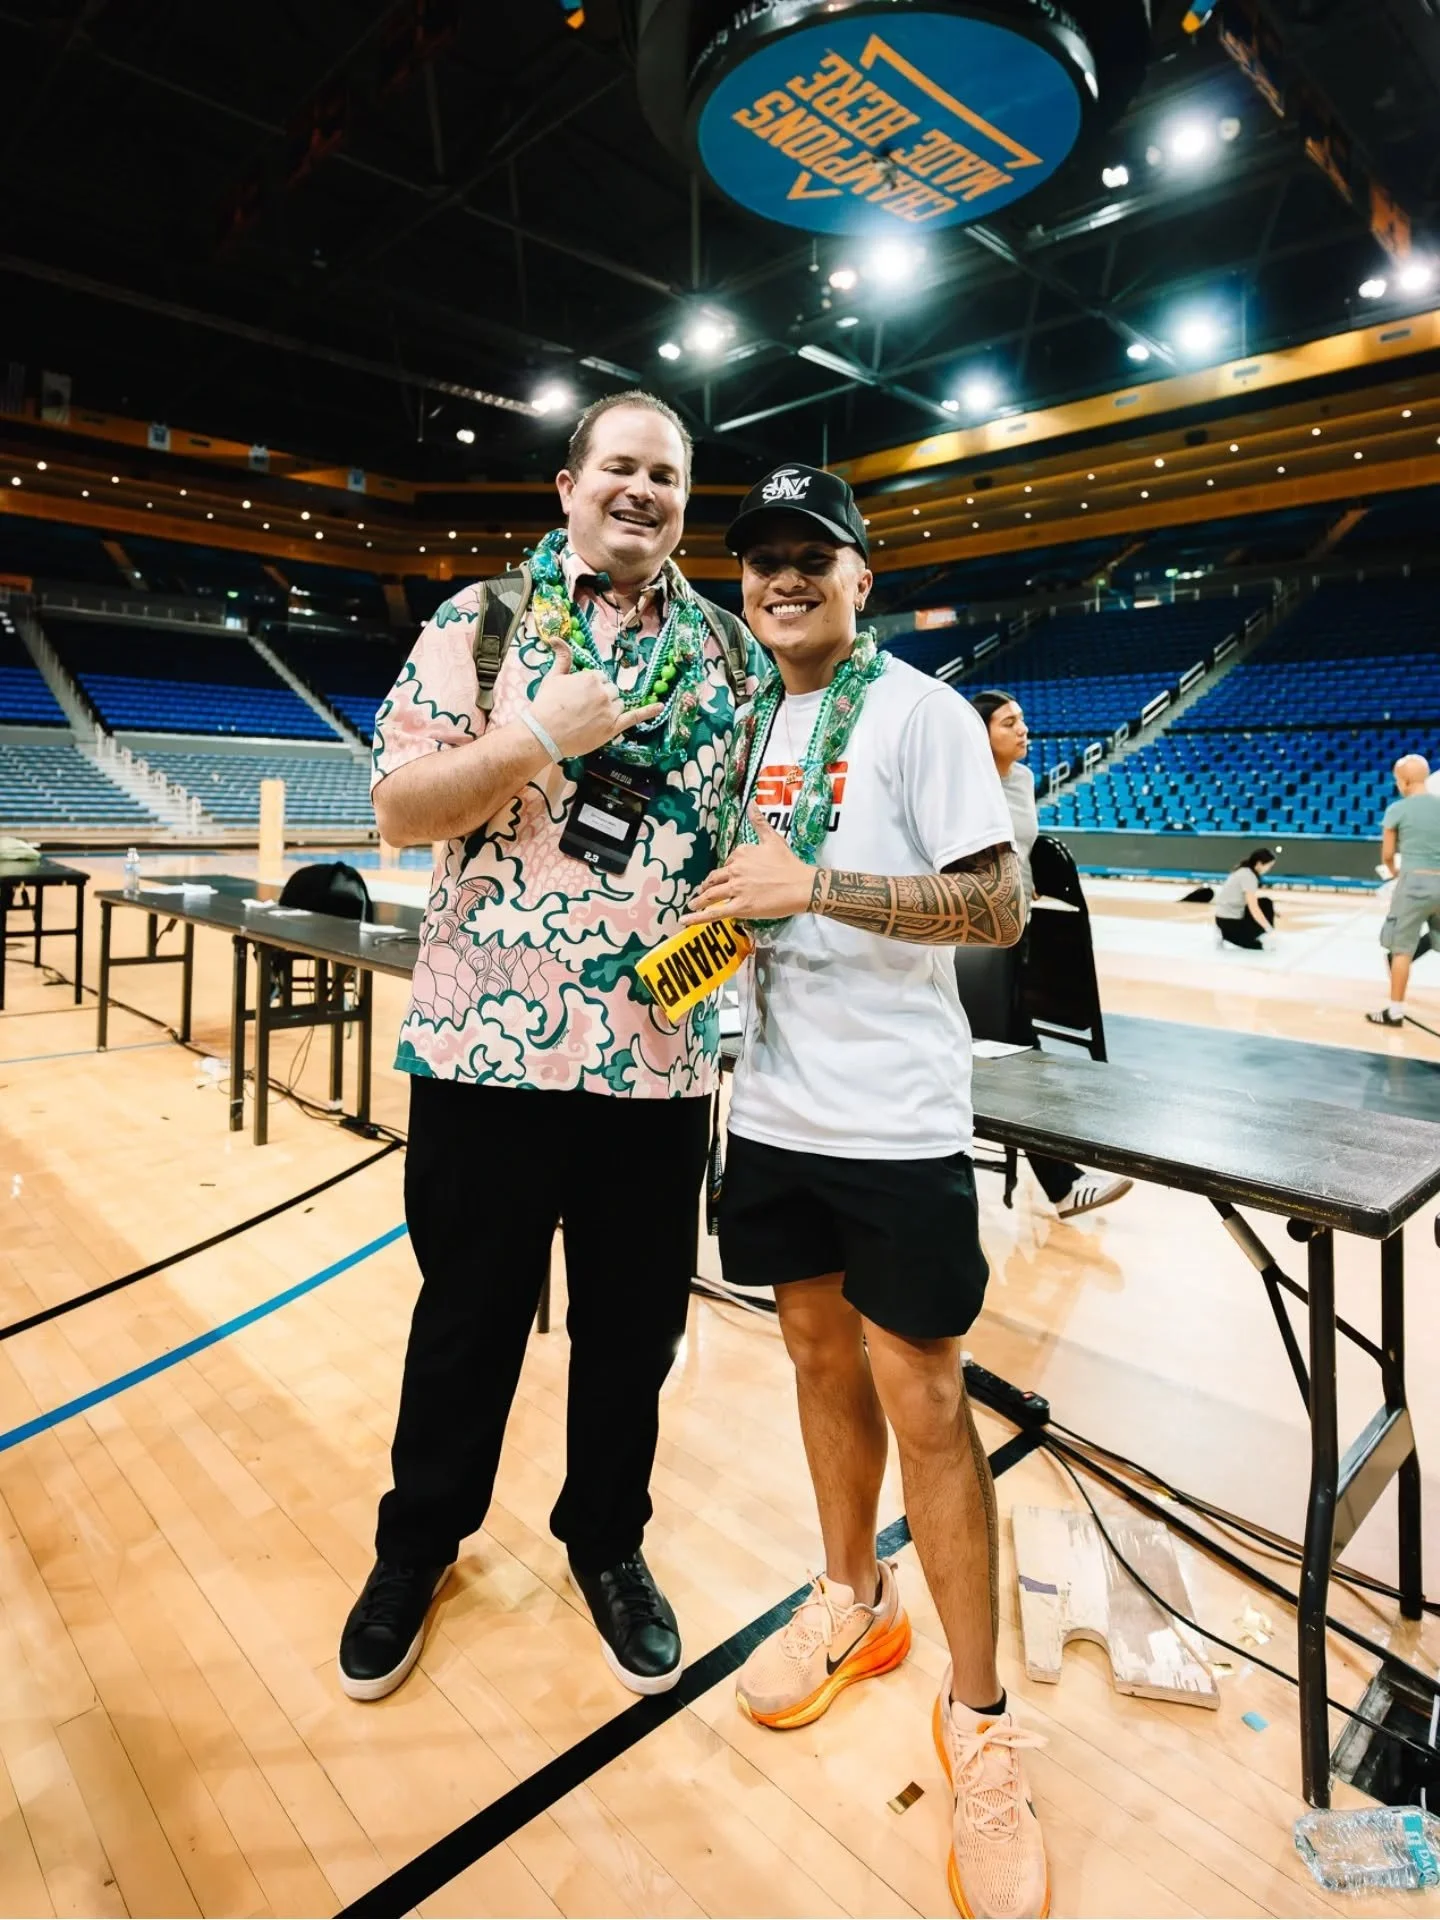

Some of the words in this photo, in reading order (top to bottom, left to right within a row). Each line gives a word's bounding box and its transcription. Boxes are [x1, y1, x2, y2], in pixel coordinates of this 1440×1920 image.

[785, 52, 921, 147] HERE
[731, 90, 957, 222] CHAMPIONS
[889, 128, 1014, 202] MADE
[610, 770, 633, 785] MEDIA
